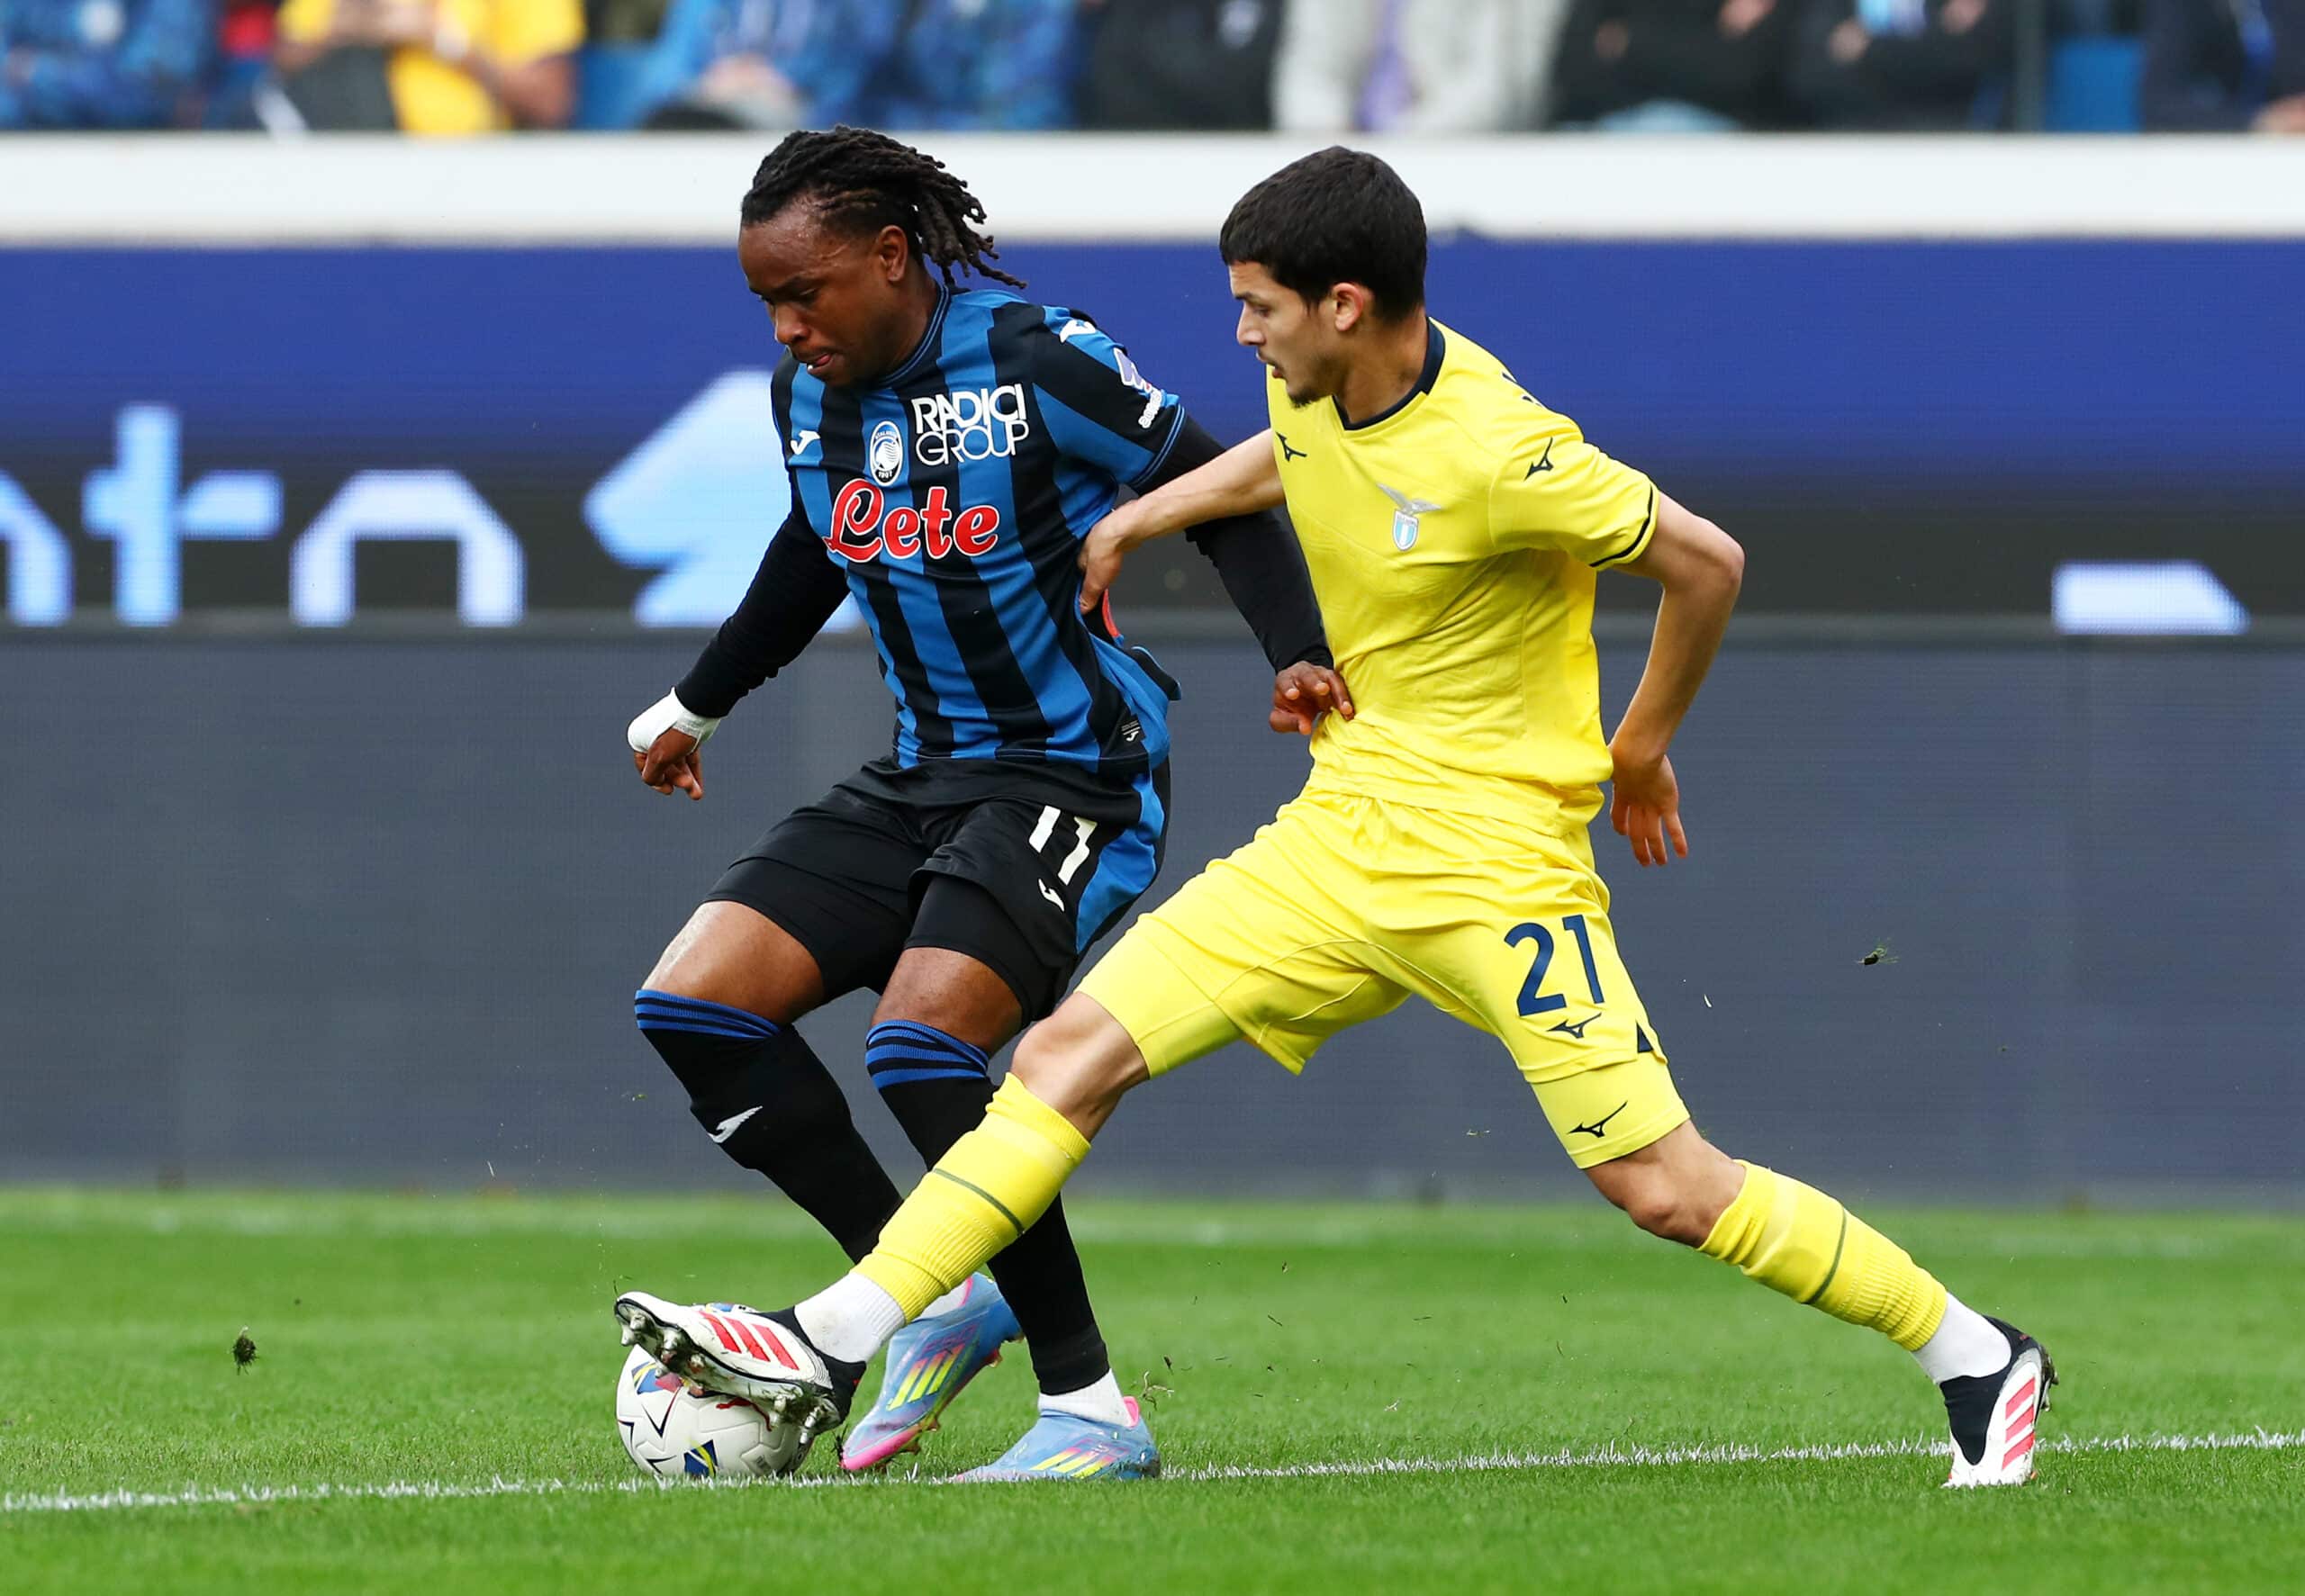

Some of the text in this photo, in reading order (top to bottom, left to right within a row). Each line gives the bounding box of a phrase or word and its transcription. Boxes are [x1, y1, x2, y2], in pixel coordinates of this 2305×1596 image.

[911, 383, 1026, 434] RADICI
[916, 419, 1029, 466] GROUP
[822, 479, 1000, 564] Lete
[1504, 914, 1604, 1017] 21
